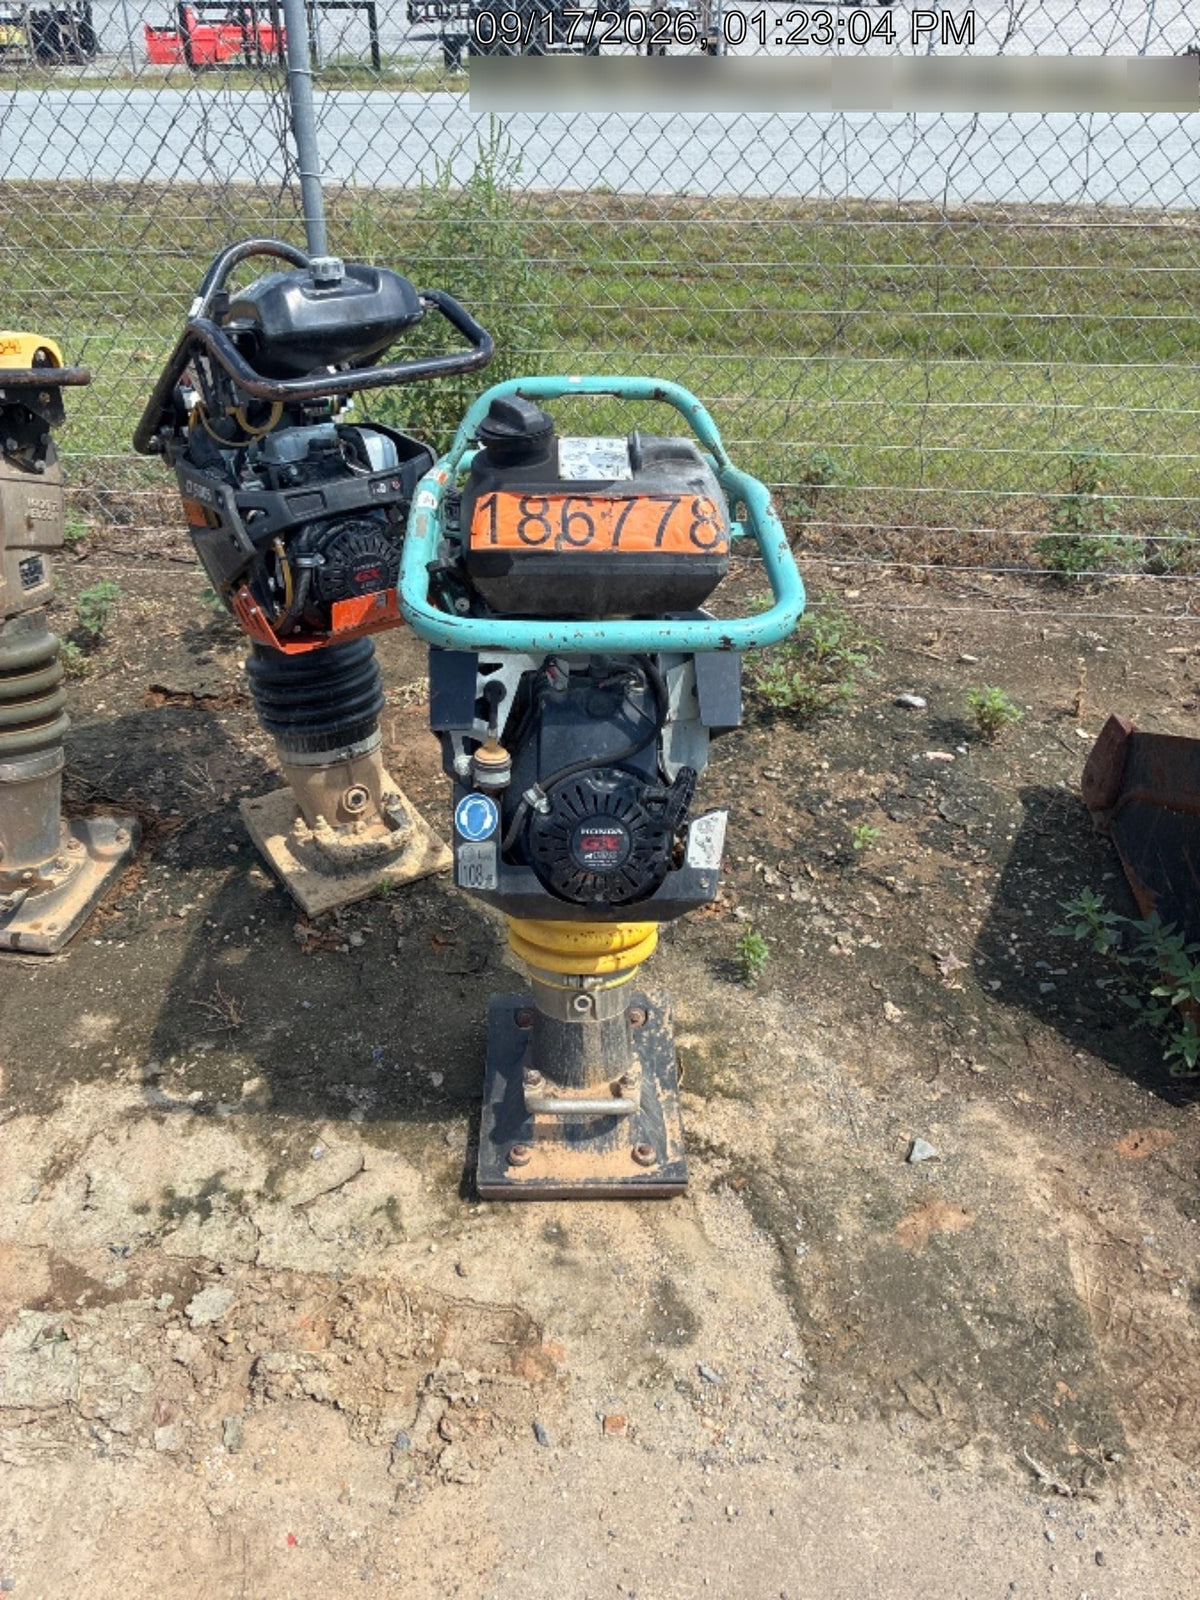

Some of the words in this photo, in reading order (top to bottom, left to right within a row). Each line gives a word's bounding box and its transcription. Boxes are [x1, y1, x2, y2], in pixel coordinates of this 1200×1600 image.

[479, 494, 722, 549] 186778
[580, 827, 623, 835] HONDA
[580, 835, 621, 852] GX
[463, 863, 485, 887] 108
